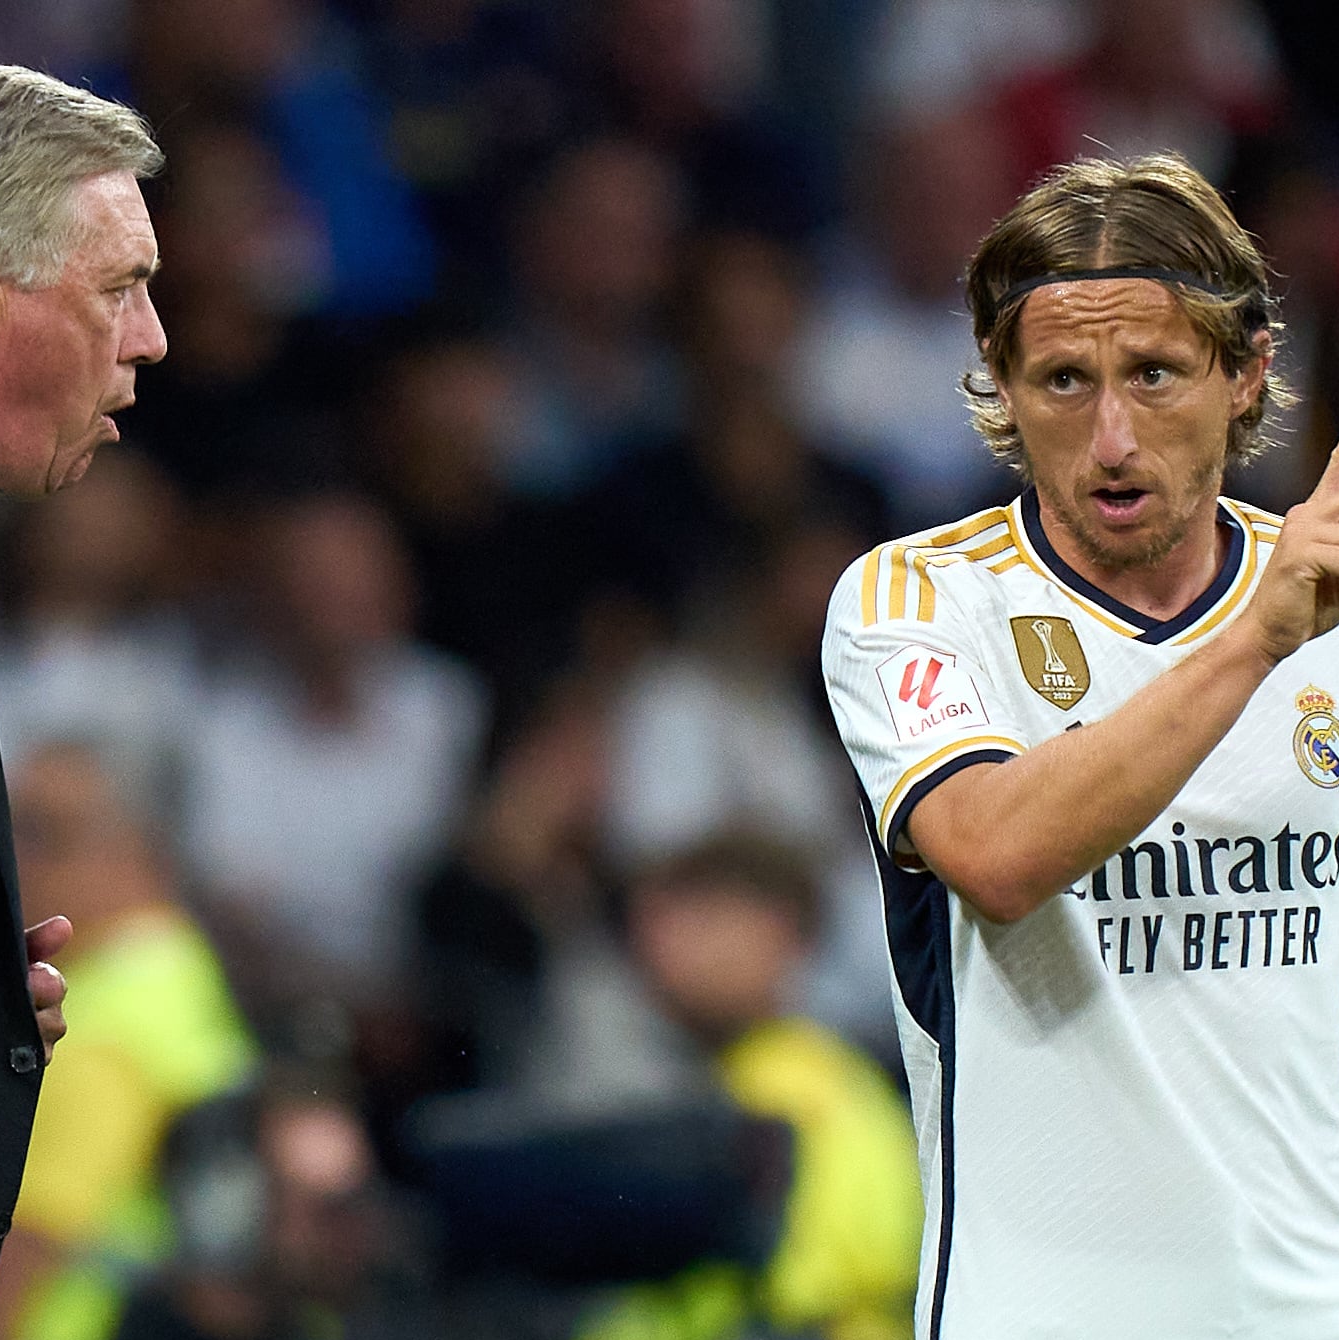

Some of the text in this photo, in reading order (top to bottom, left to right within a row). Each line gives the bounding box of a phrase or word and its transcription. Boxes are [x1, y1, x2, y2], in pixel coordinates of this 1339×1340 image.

[1042, 673, 1076, 688] FIFA
[908, 702, 973, 737] LALIGA
[1097, 906, 1322, 976] FLY BETTER
